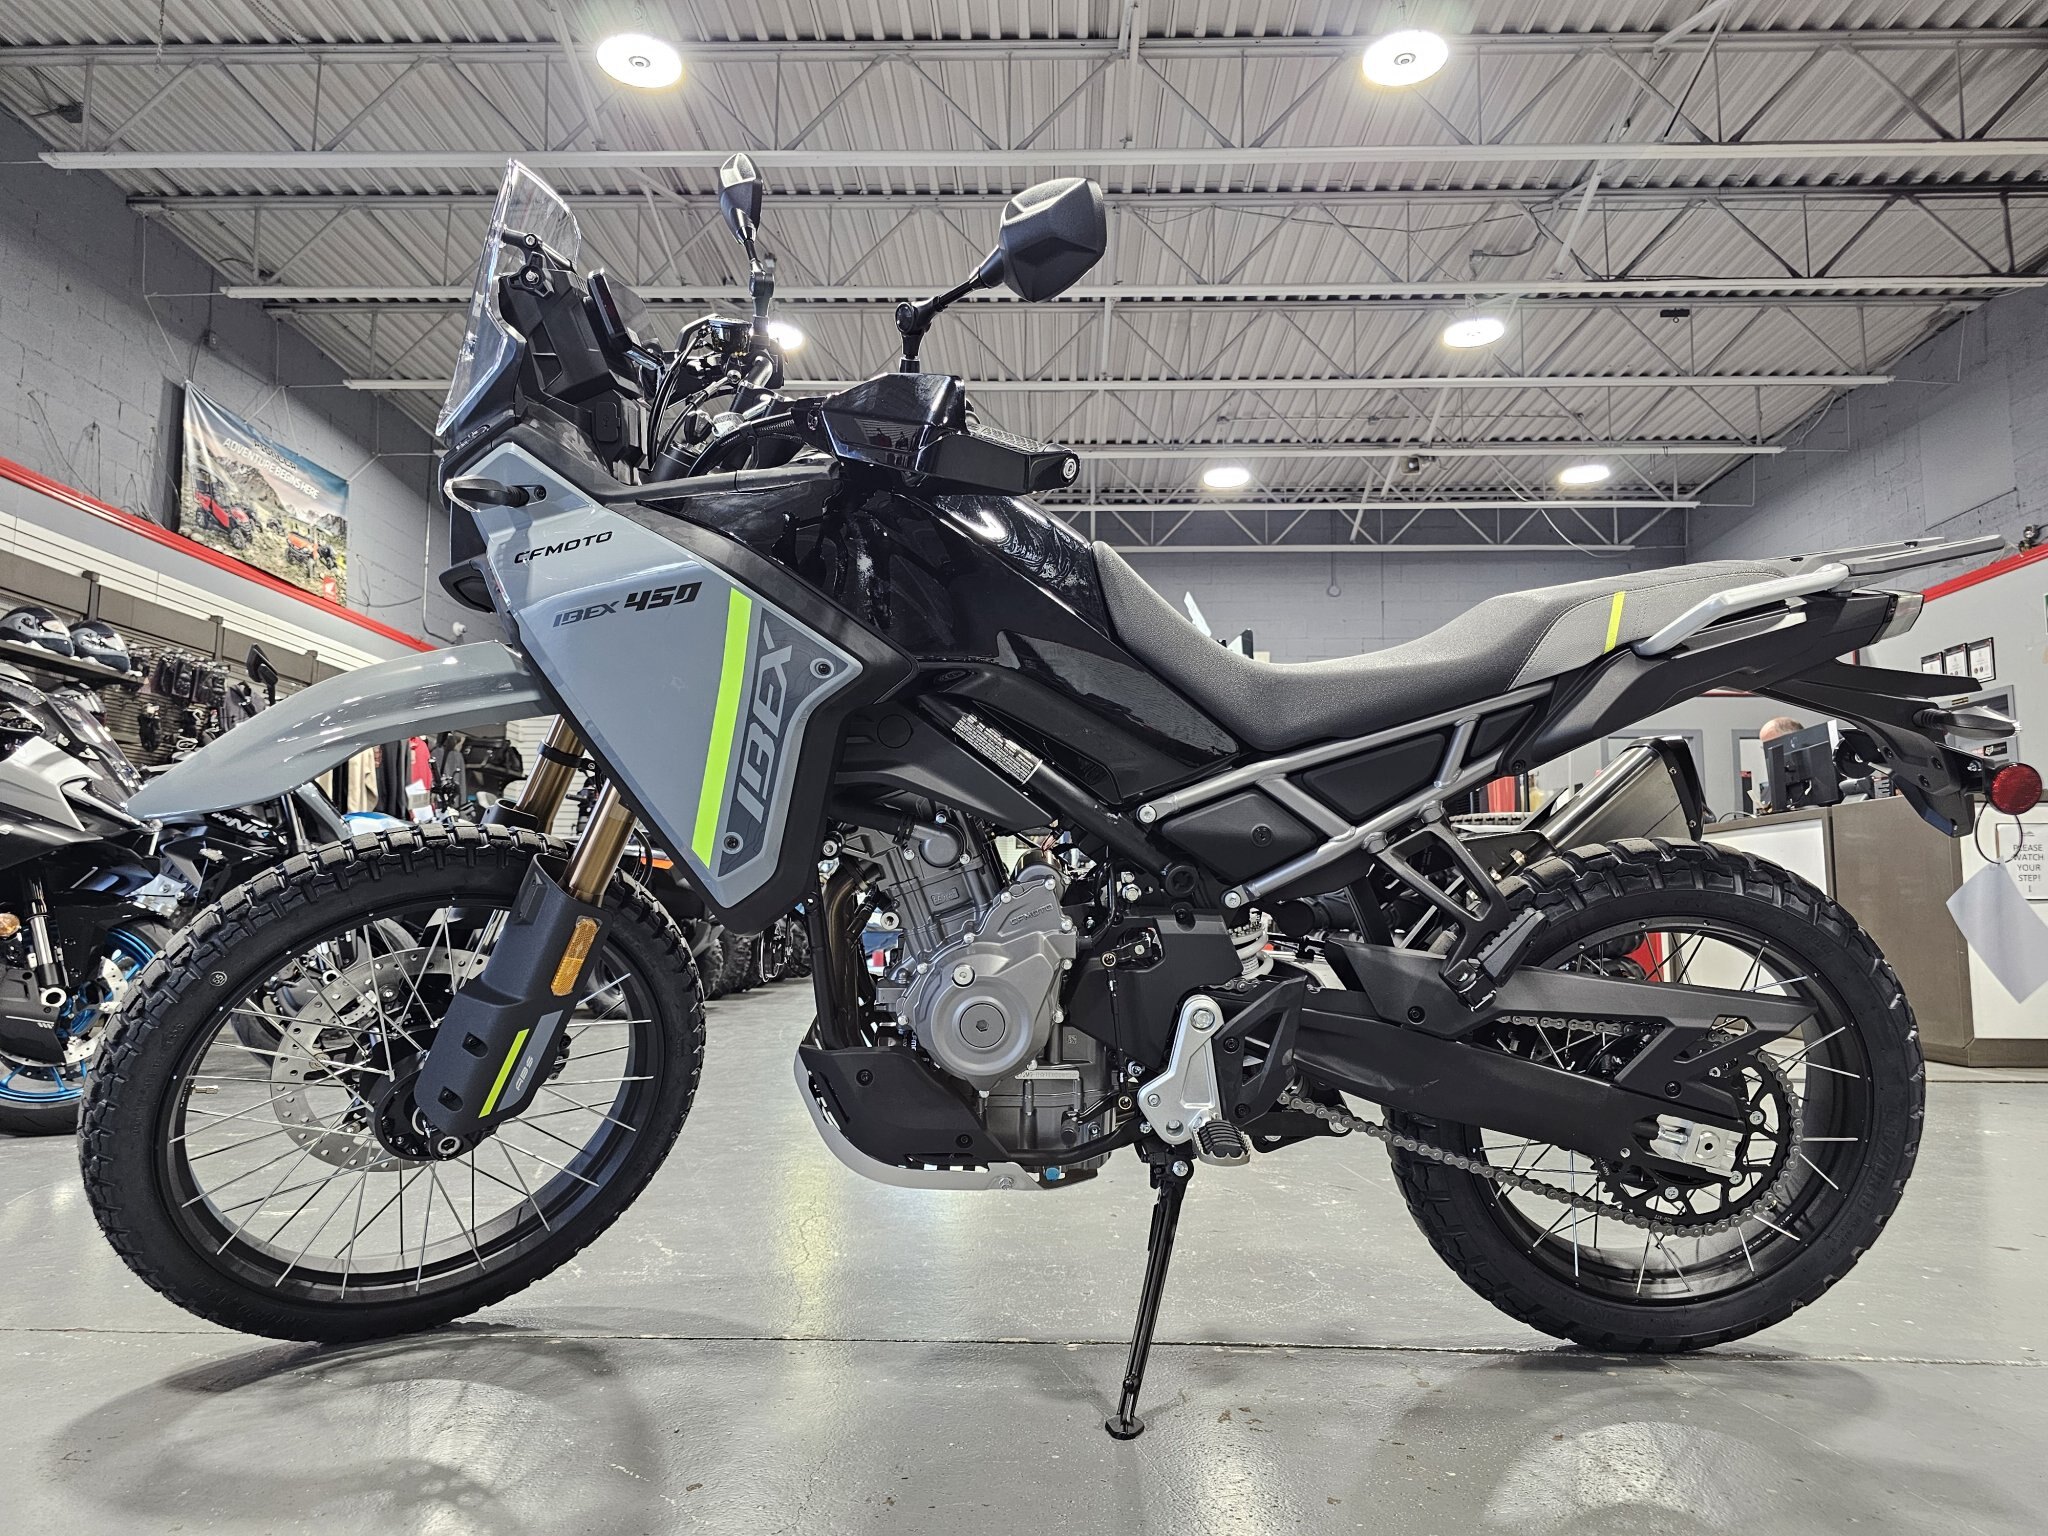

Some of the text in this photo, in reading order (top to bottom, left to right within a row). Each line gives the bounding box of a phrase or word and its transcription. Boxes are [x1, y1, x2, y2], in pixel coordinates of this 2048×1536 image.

[223, 438, 320, 499] ADVENTURE BEGINS HERE
[514, 531, 613, 564] CFMOTO
[552, 581, 703, 628] IBEX 450
[736, 620, 793, 824] IBEX
[2011, 853, 2044, 861] WATCH
[2012, 844, 2043, 852] PLEASE
[2016, 863, 2041, 872] YOUR
[2018, 874, 2041, 882] STEP!
[1010, 902, 1054, 925] CFMOTO
[515, 1055, 534, 1092] ABS
